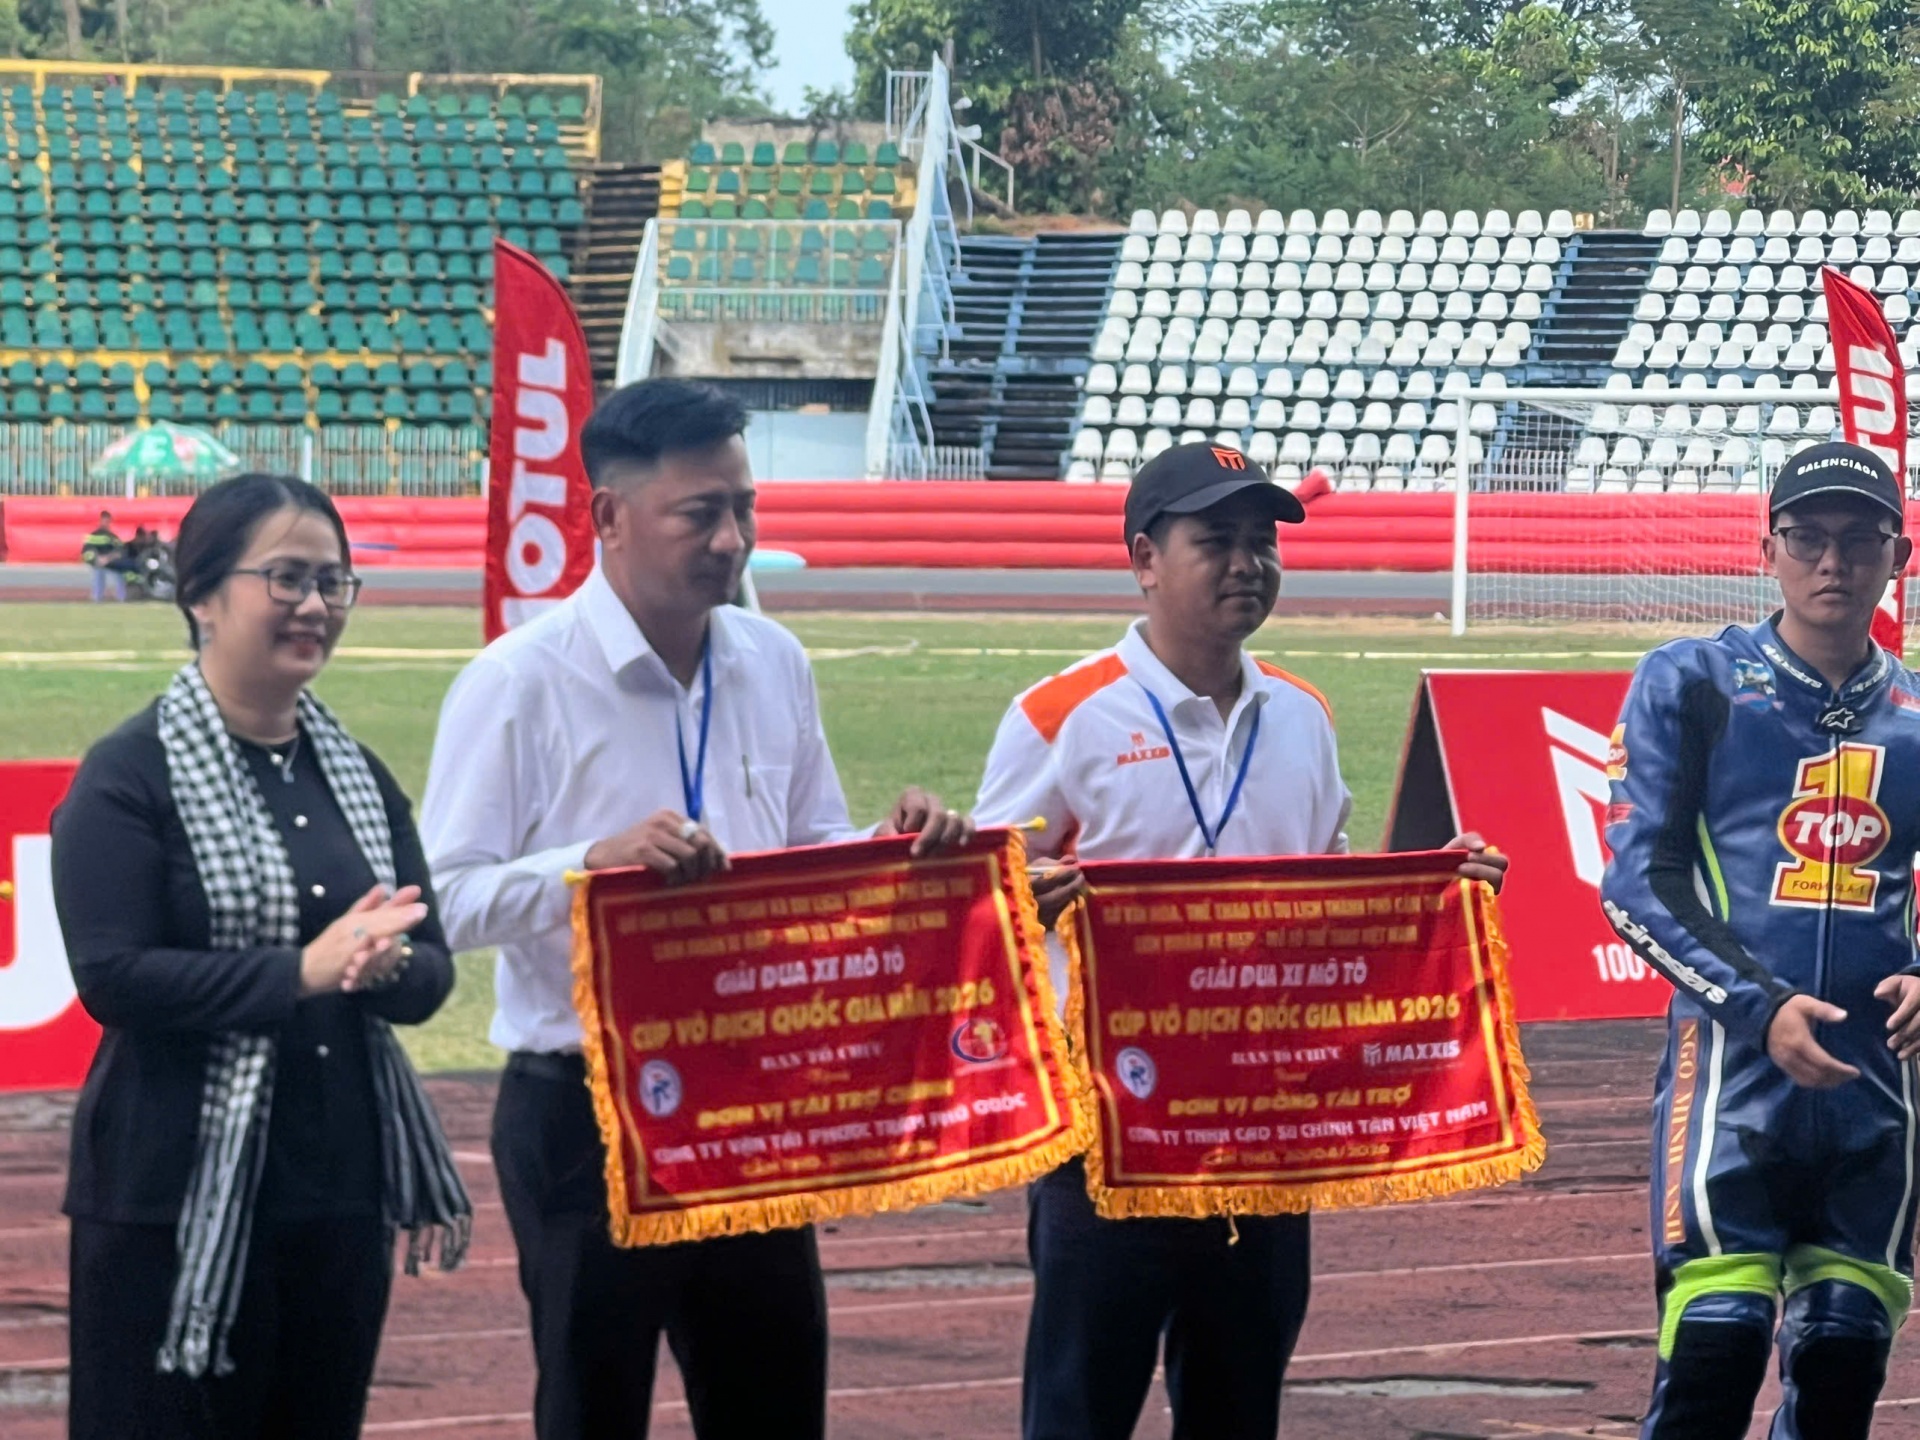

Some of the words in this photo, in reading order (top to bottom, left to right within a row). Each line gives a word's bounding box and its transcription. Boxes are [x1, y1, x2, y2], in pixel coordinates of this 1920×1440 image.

[1797, 457, 1879, 480] BALENCIAGA
[1795, 811, 1881, 848] TOP
[1593, 943, 1658, 982] 100
[1304, 1002, 1343, 1029] GIA
[1346, 994, 1397, 1027] NĂM
[1400, 992, 1461, 1023] 2026
[1384, 1040, 1461, 1063] MAXXIS
[1445, 1100, 1489, 1125] NAM
